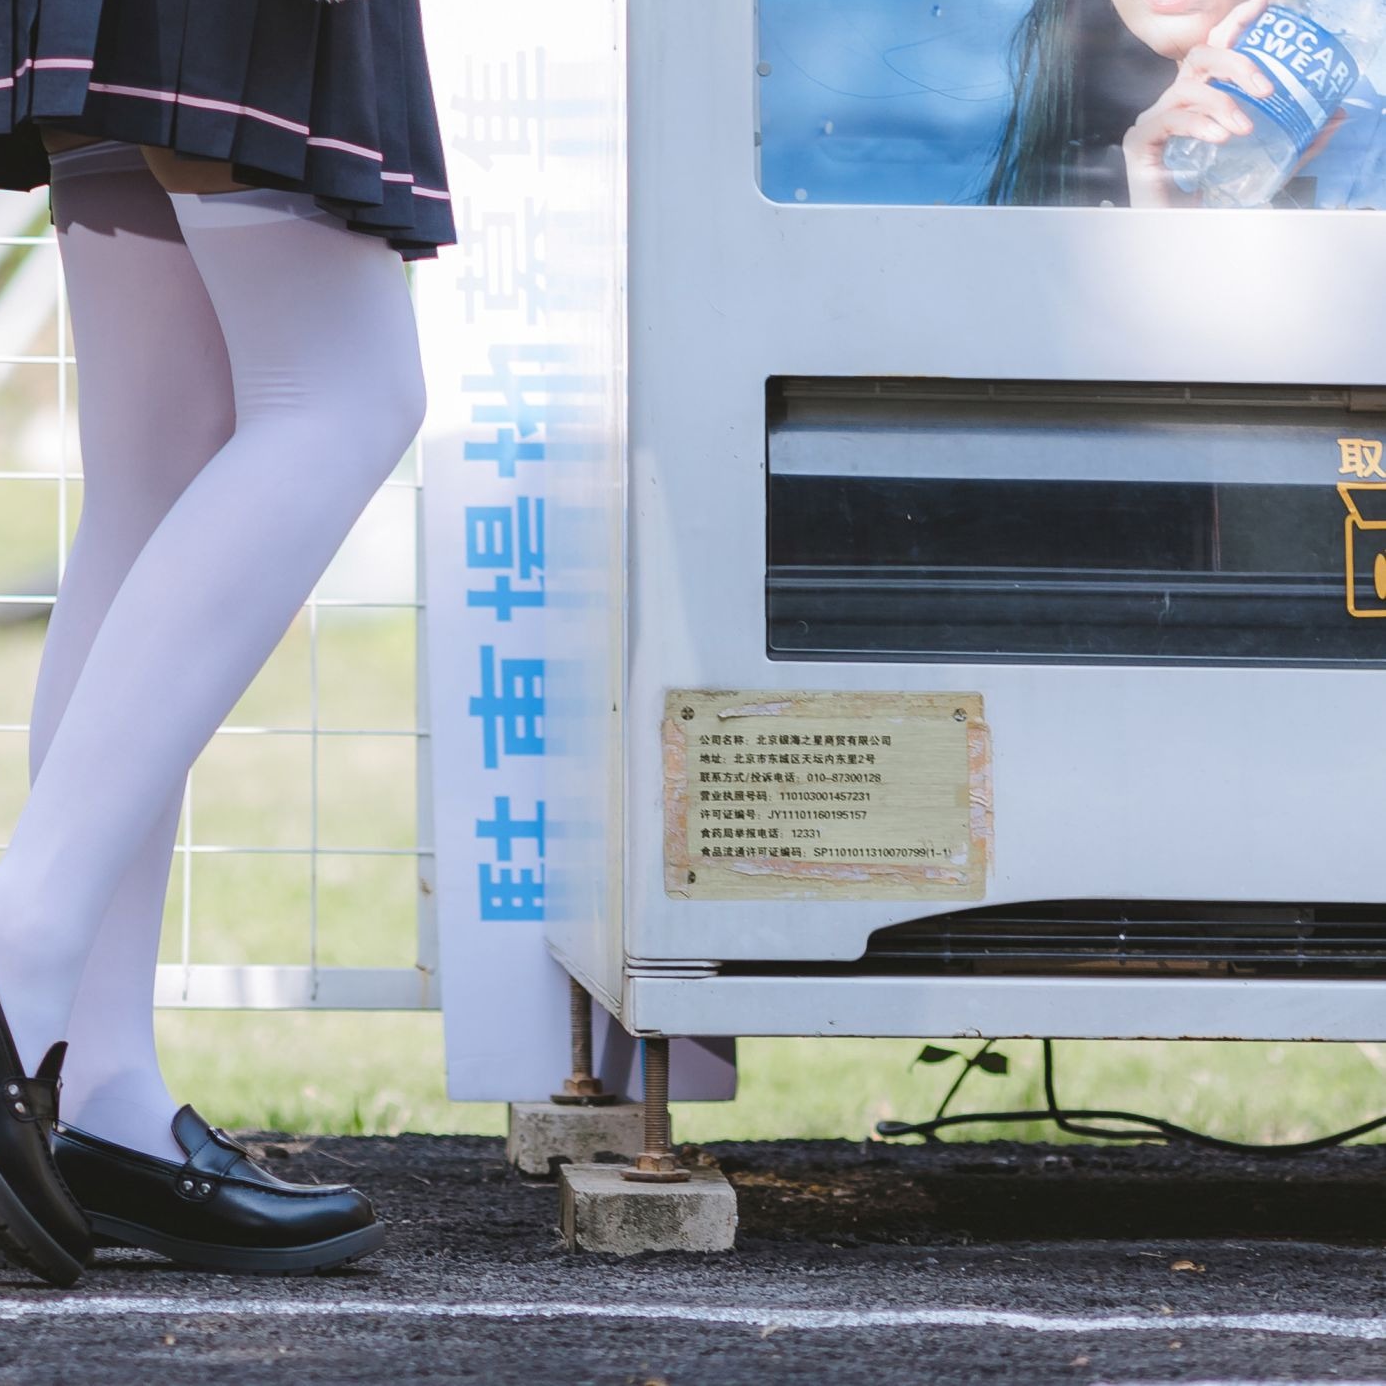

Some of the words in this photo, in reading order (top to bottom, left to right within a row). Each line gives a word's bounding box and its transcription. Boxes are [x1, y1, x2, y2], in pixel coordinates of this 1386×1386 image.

[1245, 28, 1340, 100] SWEAT
[1256, 11, 1355, 95] POCARI
[1337, 437, 1386, 478] 取
